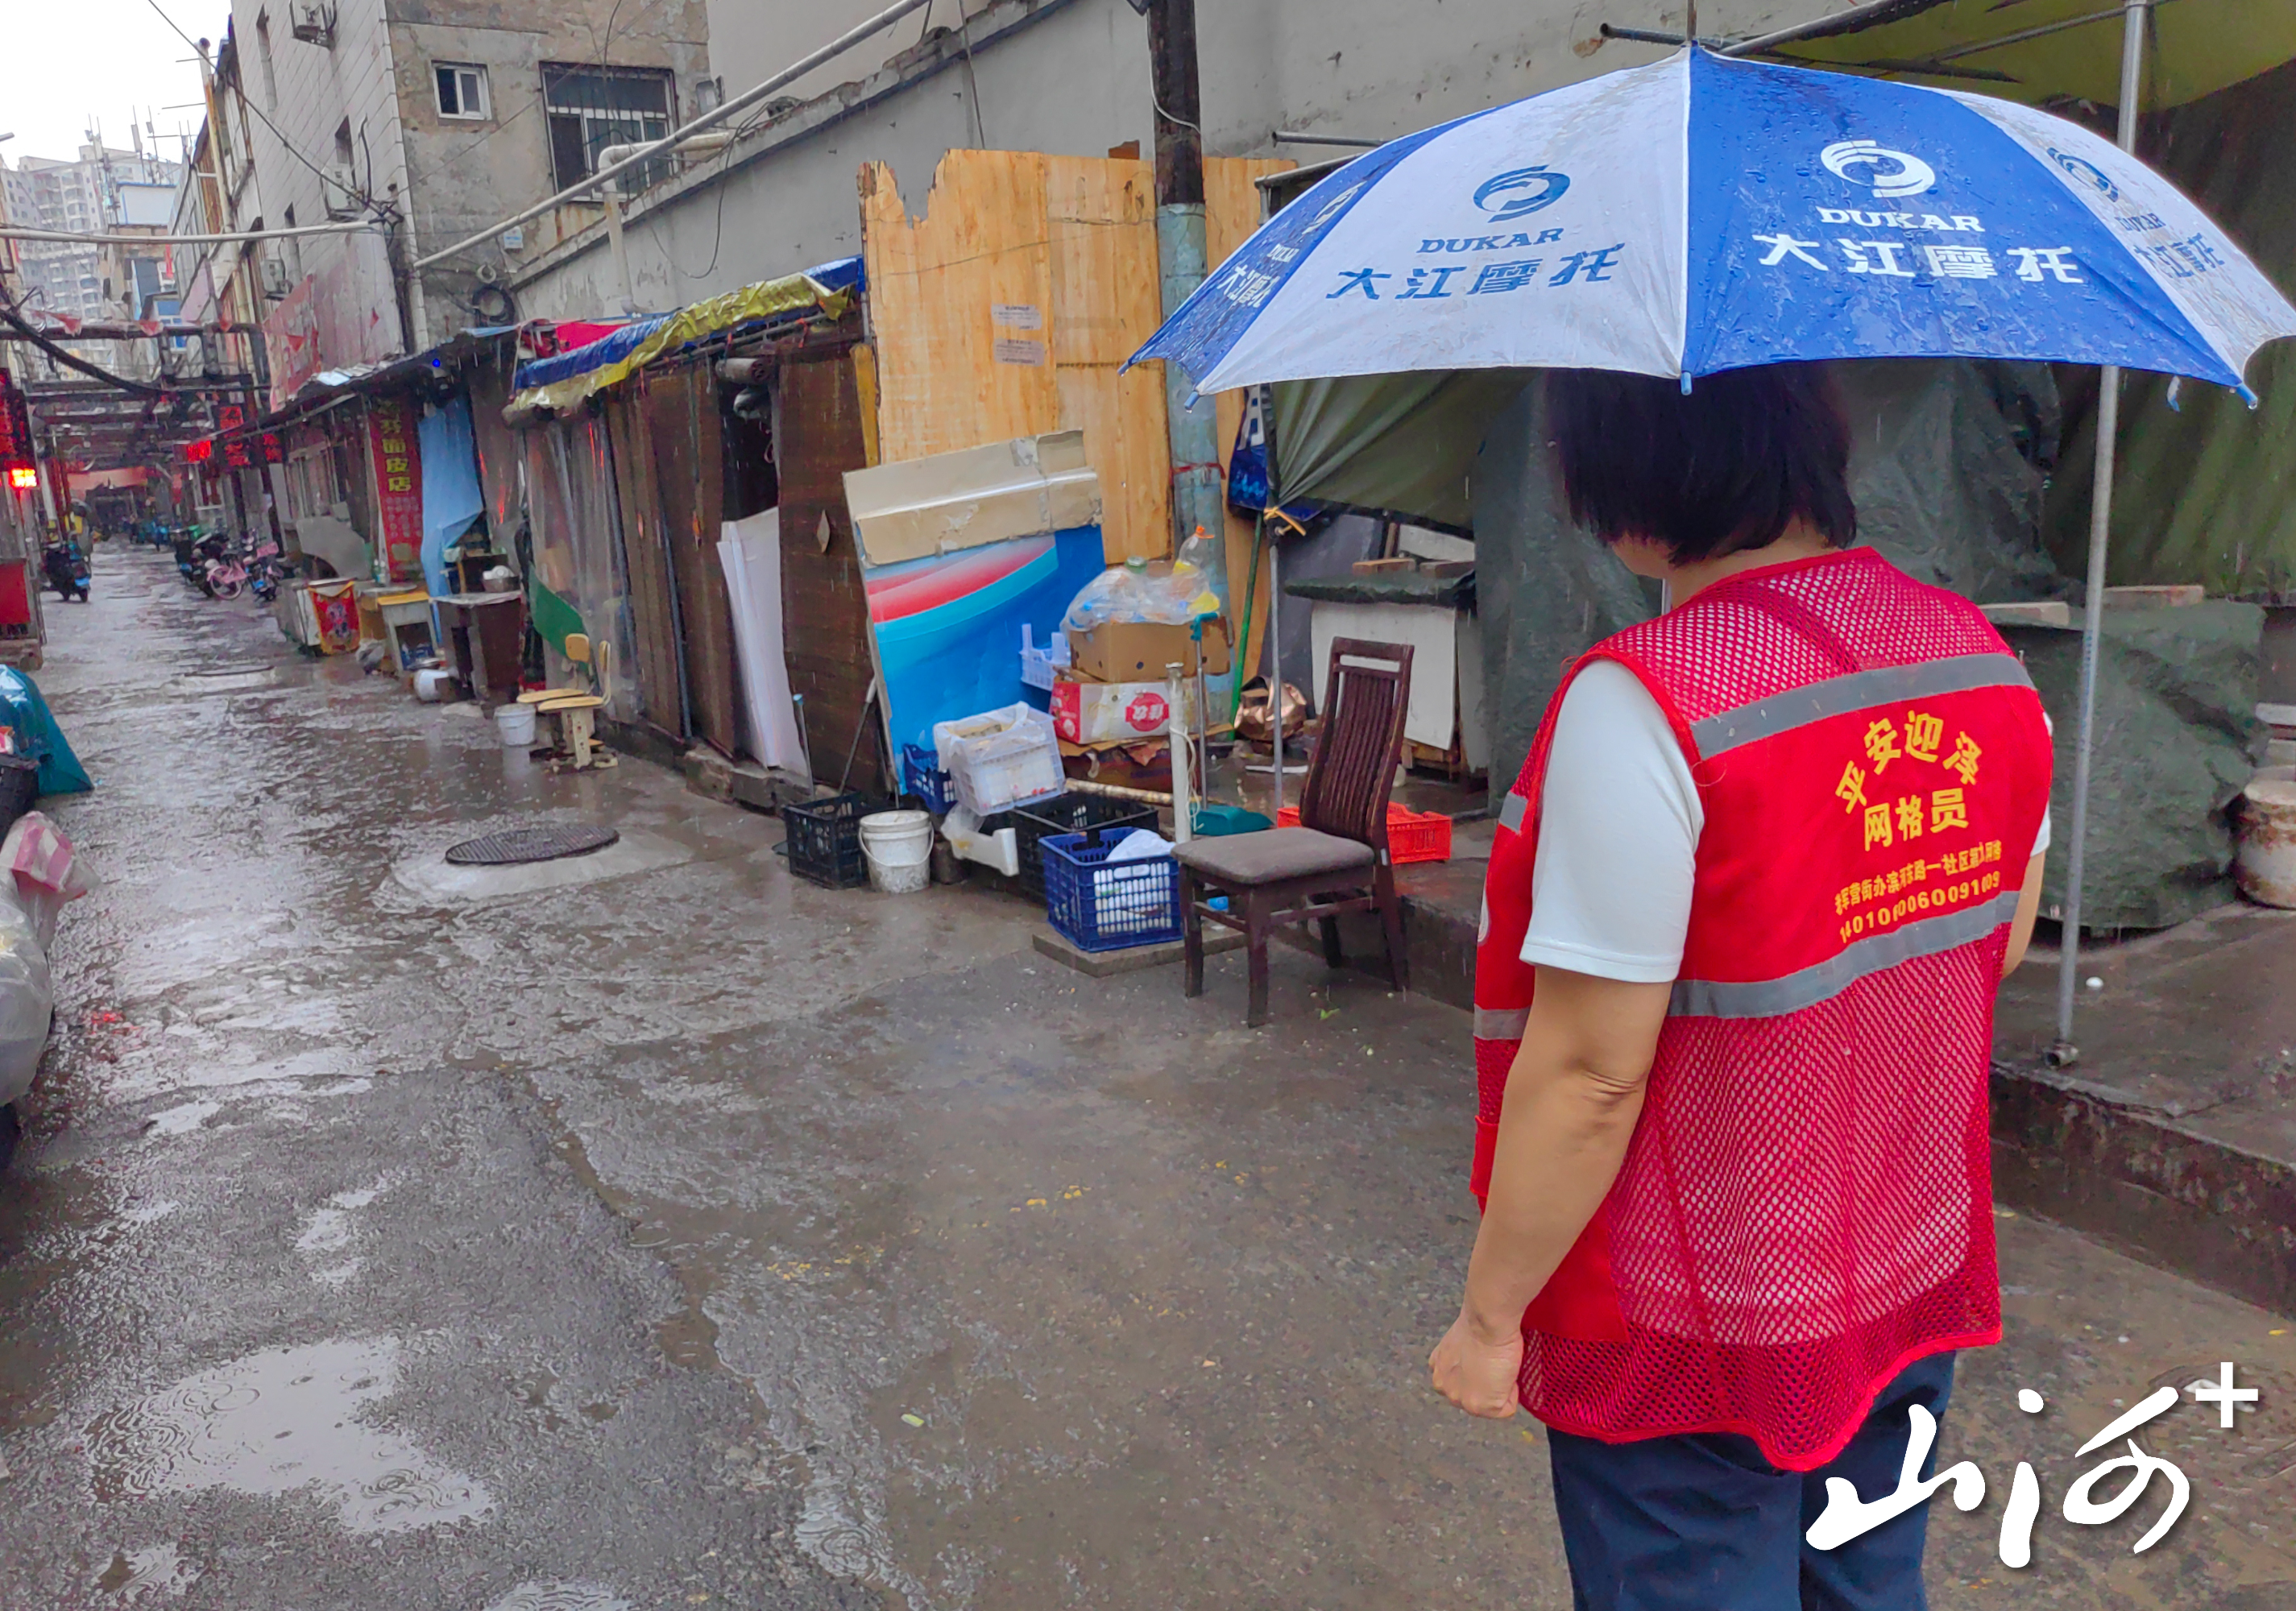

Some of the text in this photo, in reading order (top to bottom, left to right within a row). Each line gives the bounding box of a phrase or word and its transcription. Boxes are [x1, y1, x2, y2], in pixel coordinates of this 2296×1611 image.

[1415, 227, 1565, 254] DUKAR
[1816, 206, 1985, 232] DUKAR
[1326, 242, 1626, 301] 大江摩托
[1752, 233, 2085, 285] 大江摩托
[2133, 232, 2226, 279] 大江摩托
[1834, 710, 1983, 815] 平安迎泽
[1864, 787, 1969, 852] 网格员
